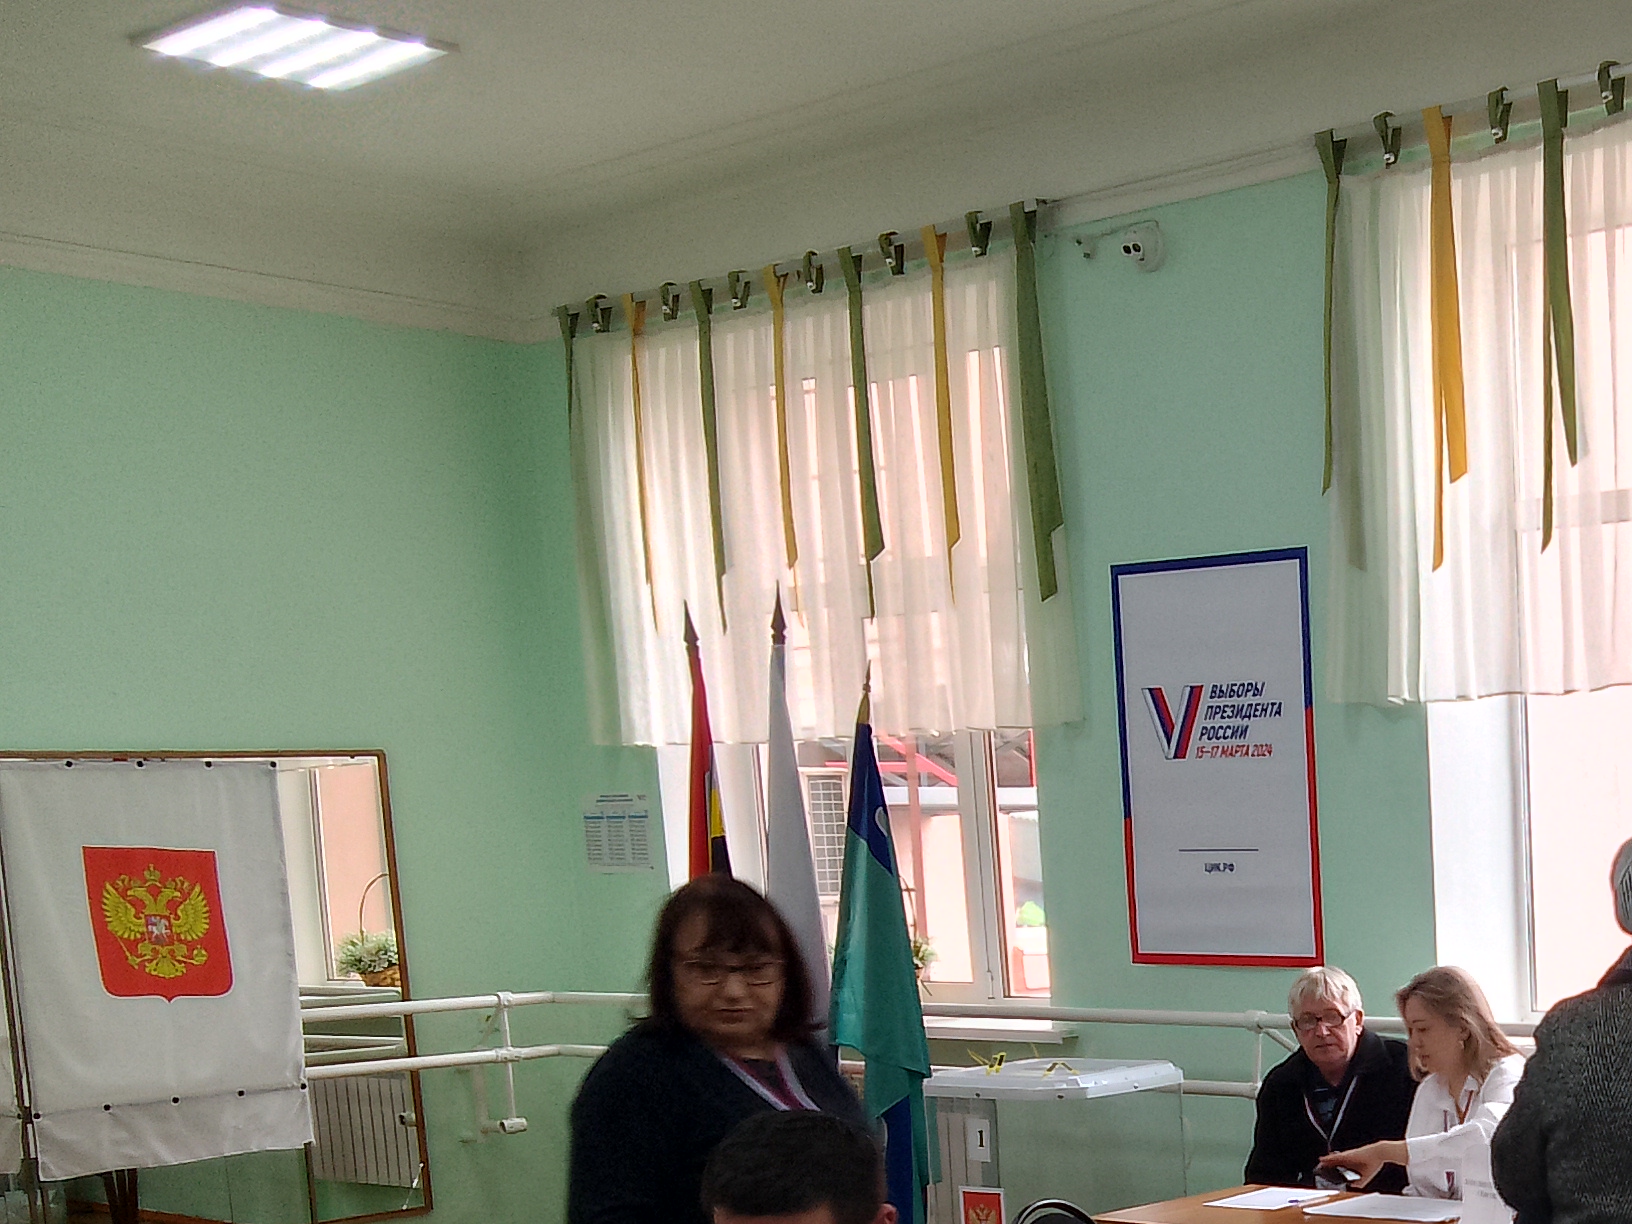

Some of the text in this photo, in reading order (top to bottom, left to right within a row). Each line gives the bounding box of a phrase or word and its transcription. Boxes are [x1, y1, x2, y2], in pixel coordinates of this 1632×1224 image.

[1209, 681, 1265, 699] ВЫБОРЫ
[1203, 701, 1282, 721] ПРЕЗИДЕНТА
[1198, 725, 1249, 741] РОССИИ
[1220, 744, 1250, 758] МАРТА
[1250, 743, 1273, 757] 2024
[976, 1129, 986, 1148] 1
